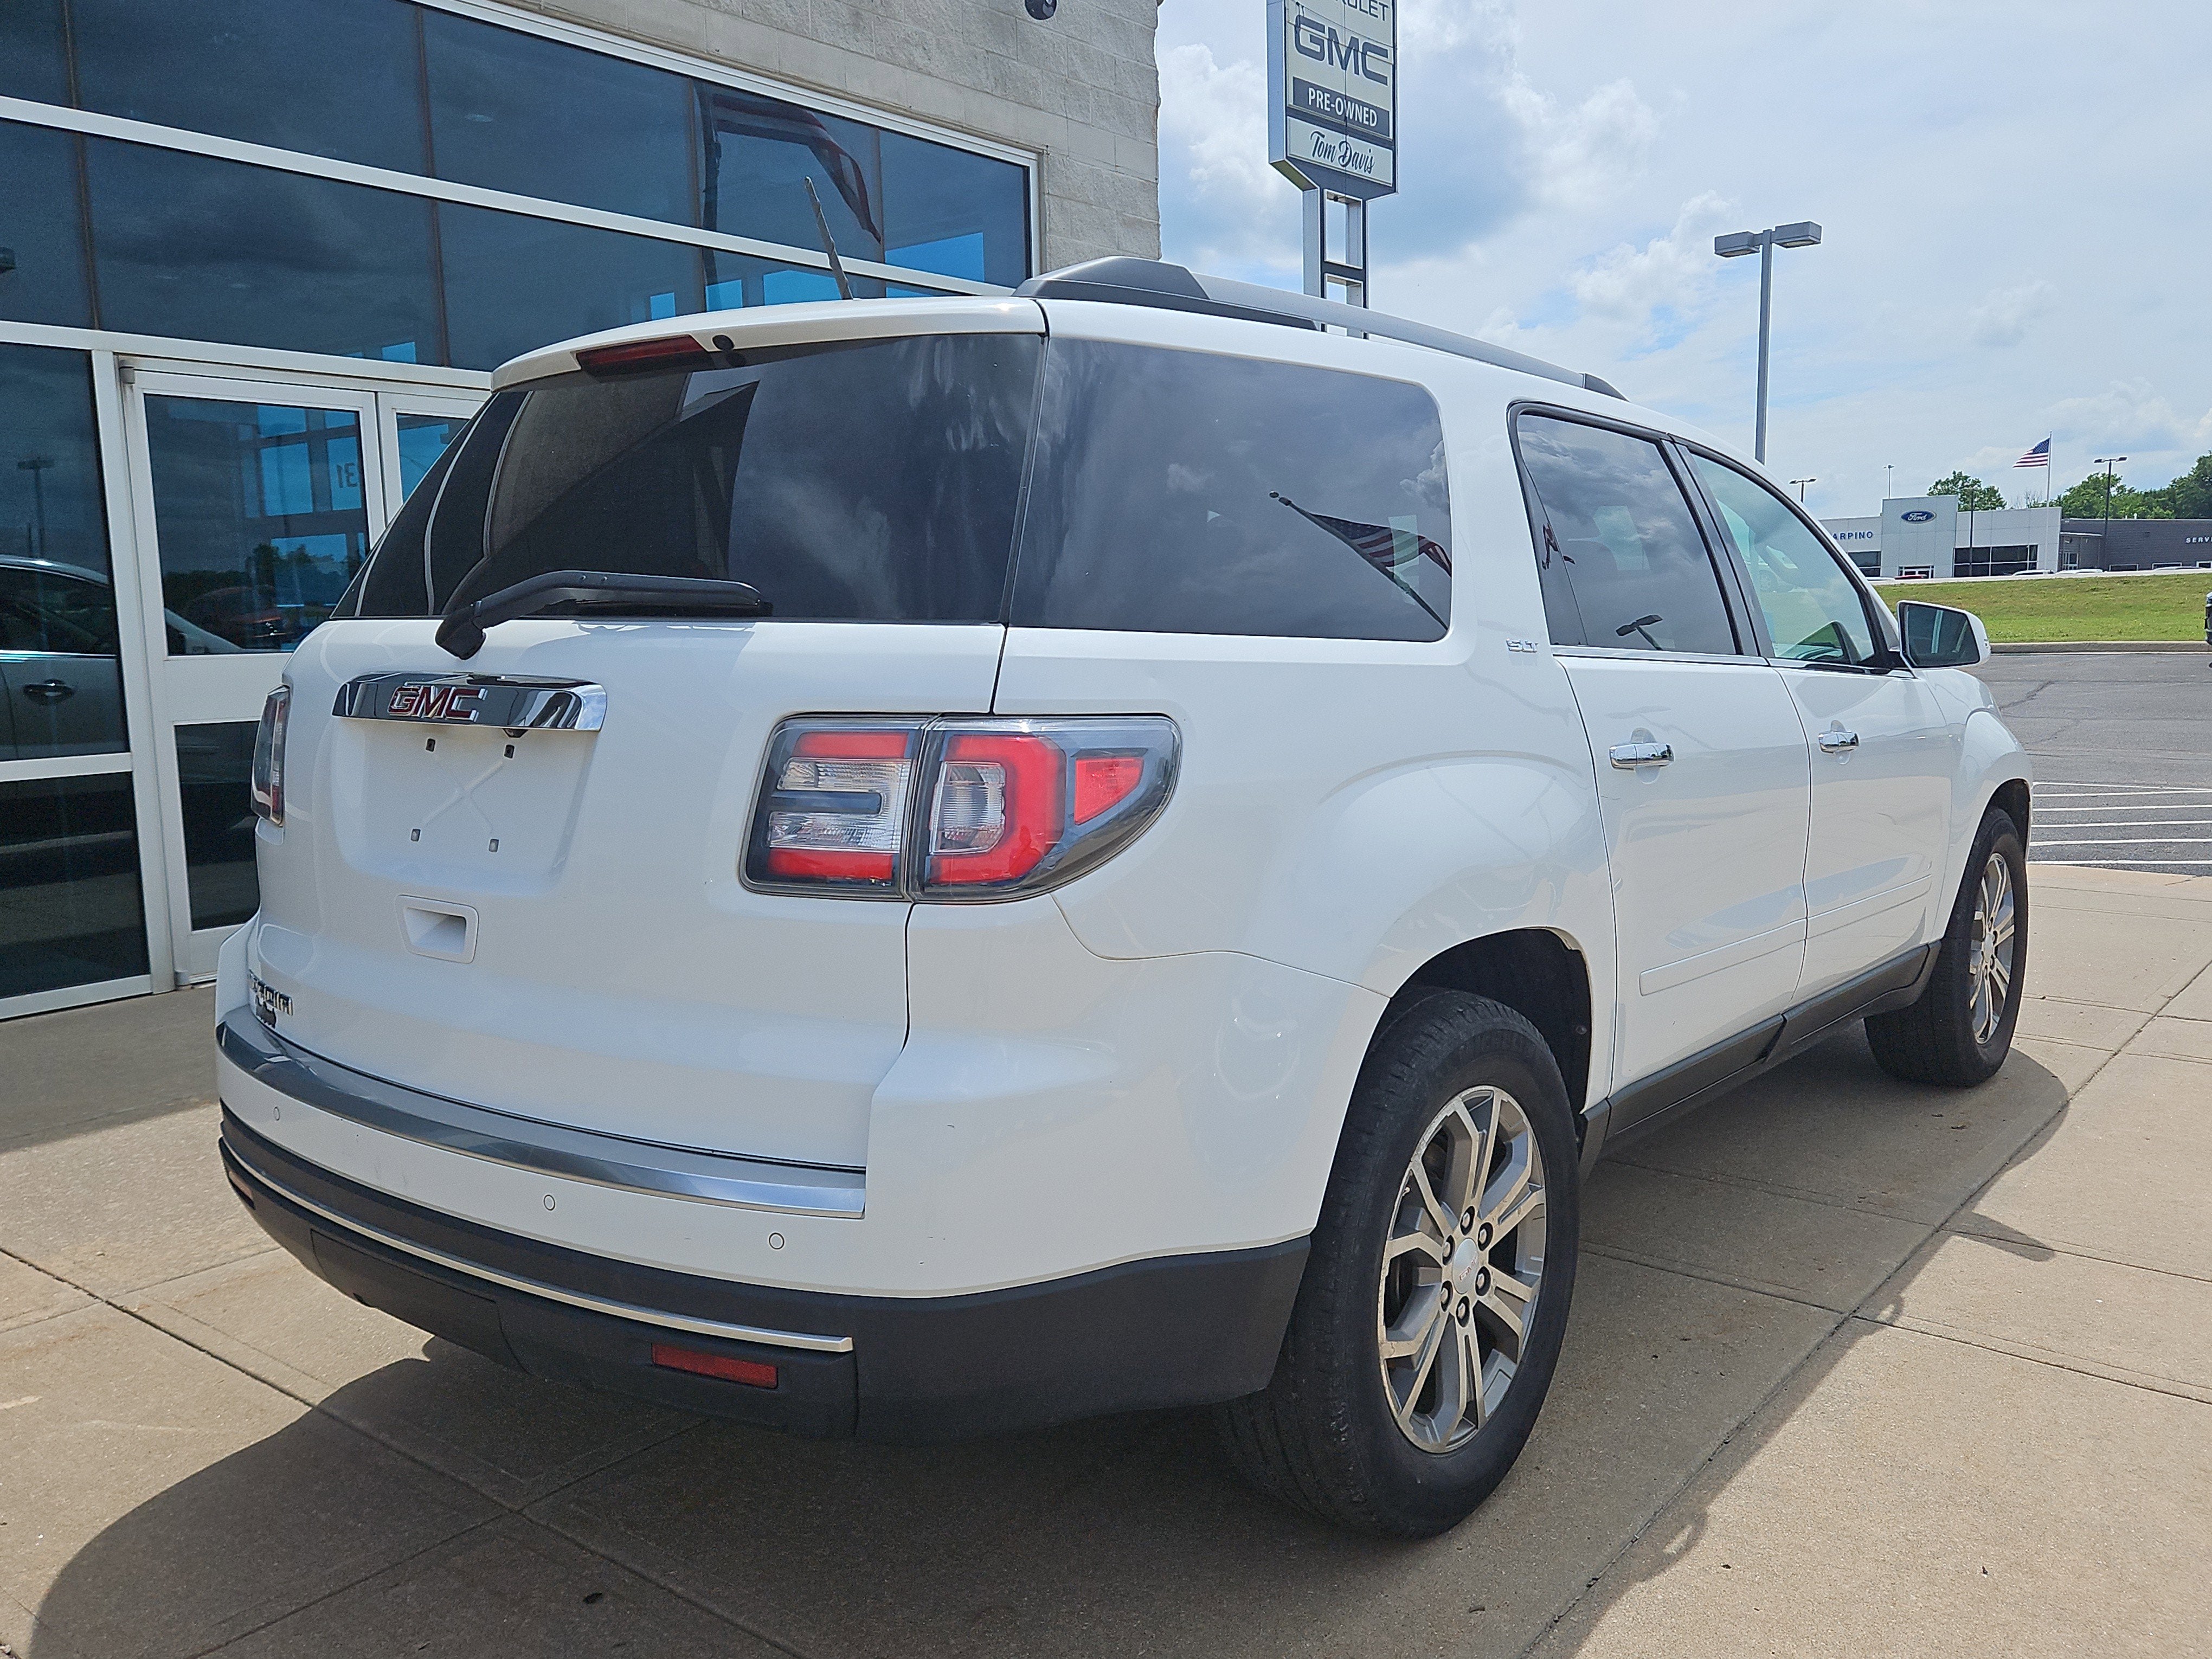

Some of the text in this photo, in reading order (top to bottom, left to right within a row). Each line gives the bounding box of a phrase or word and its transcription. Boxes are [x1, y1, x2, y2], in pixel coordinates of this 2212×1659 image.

[1294, 14, 1388, 86] GMC
[1308, 87, 1378, 127] PRE-OWNED
[1310, 131, 1375, 174] Tom Davis
[1506, 639, 1539, 653] SLT
[387, 684, 488, 723] GMC
